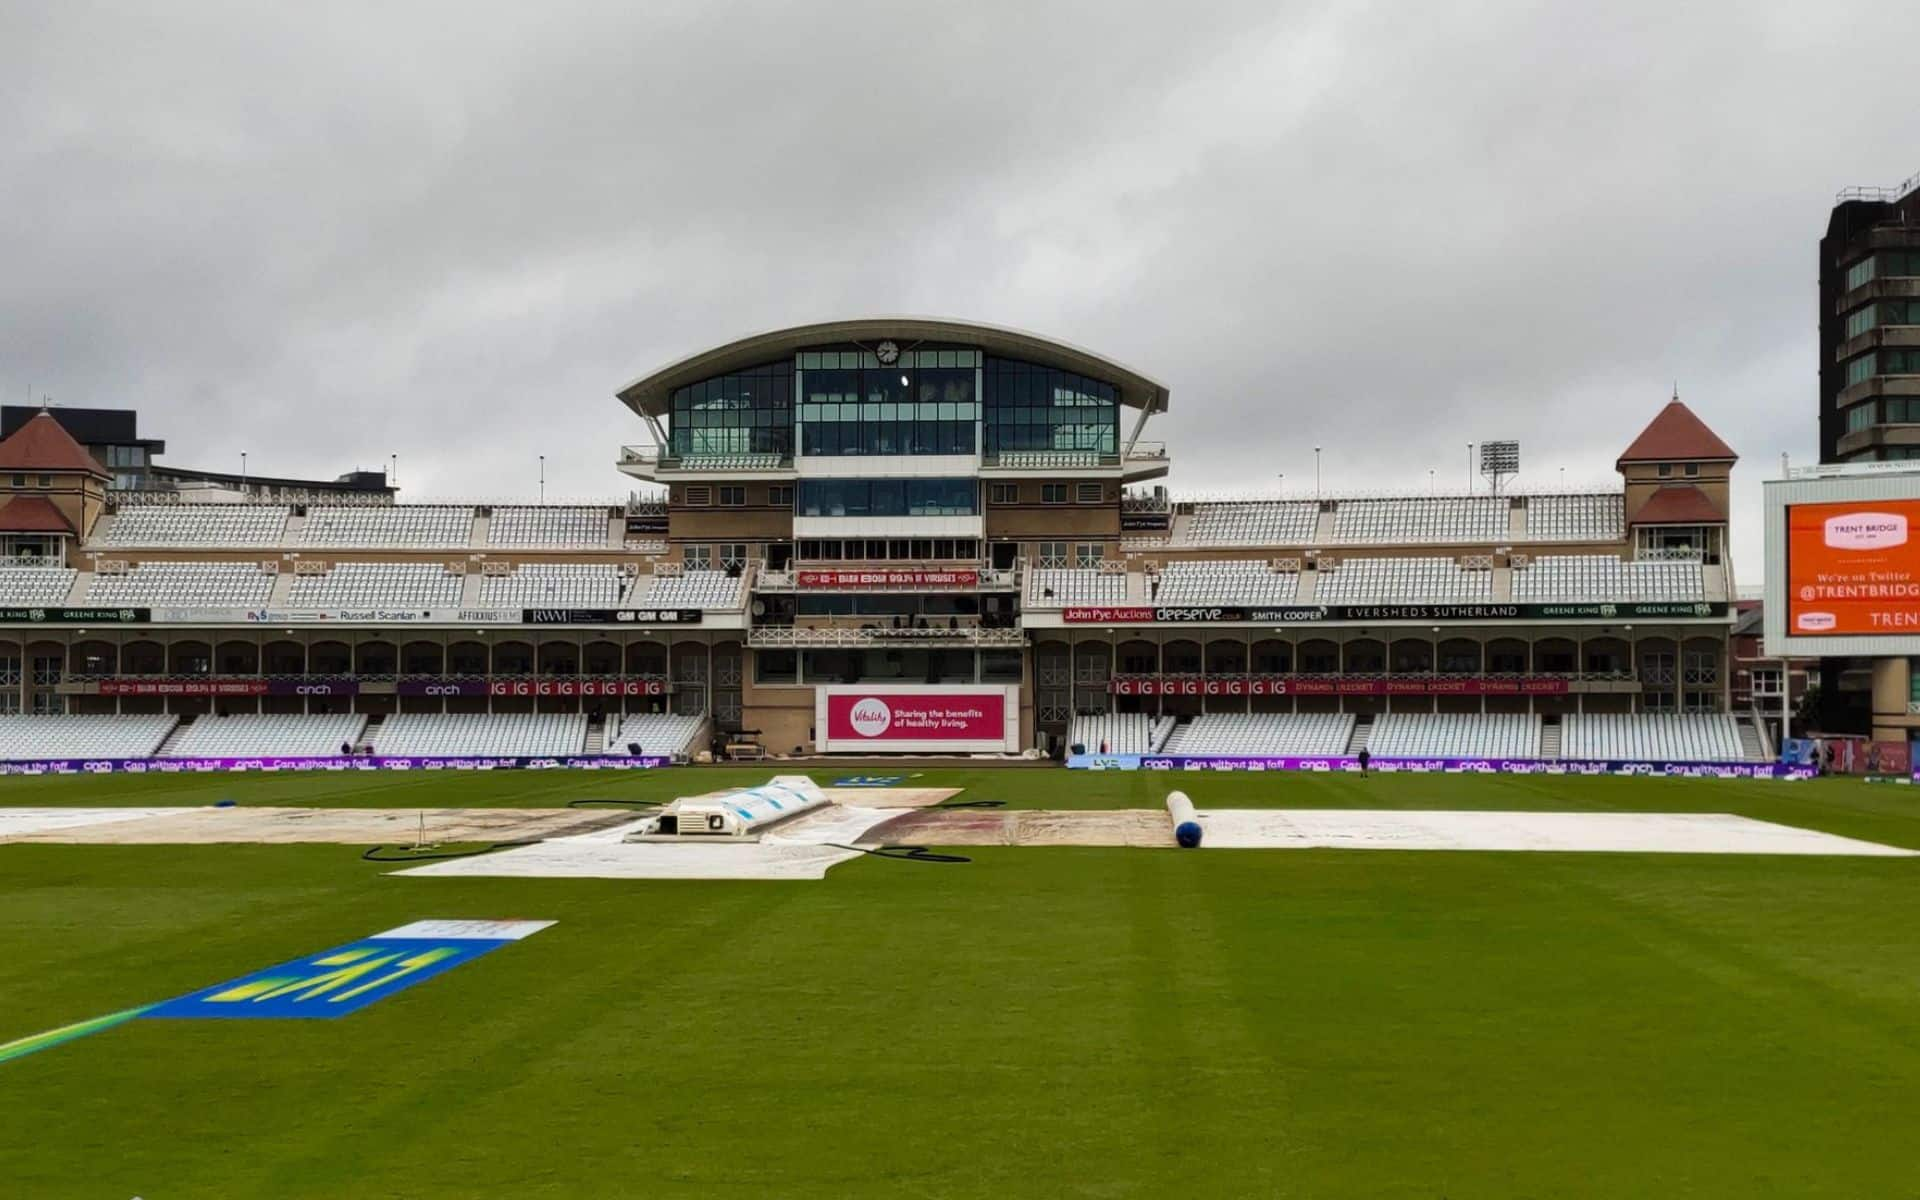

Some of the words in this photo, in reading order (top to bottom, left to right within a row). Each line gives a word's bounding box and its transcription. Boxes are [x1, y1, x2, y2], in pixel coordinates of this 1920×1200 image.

[1834, 525, 1863, 533] TRENT
[1866, 523, 1898, 532] BRIDGE
[1817, 573, 1848, 583] We're
[1869, 571, 1911, 581] Twitter
[1800, 583, 1920, 601] @TRENTBRIDG
[29, 608, 46, 621] IPA
[119, 608, 136, 621] IPA
[1347, 607, 1429, 617] EVERSHEDS
[1434, 606, 1518, 617] SUTHERLAND
[1578, 606, 1600, 615] KING
[1672, 605, 1693, 614] KING
[1695, 602, 1712, 617] IPA
[340, 611, 376, 621] Russell
[377, 611, 417, 621] Scanlan
[532, 610, 567, 623] RWM
[1065, 610, 1091, 621] John
[1093, 610, 1112, 622] Pye
[1113, 609, 1152, 621] Auctions
[1252, 611, 1281, 621] SMITH
[1284, 610, 1323, 621] COOPER
[1870, 612, 1919, 626] TREN
[296, 685, 332, 695] cinch
[425, 685, 460, 695] cinch
[491, 682, 506, 695] IG
[513, 682, 528, 695] IG
[535, 682, 551, 695] IG
[557, 682, 573, 695] IG
[580, 682, 595, 695] IG
[602, 682, 617, 695] IG
[624, 682, 639, 695] IG
[645, 682, 660, 695] IG
[1115, 681, 1131, 694] IG
[1138, 681, 1153, 694] IG
[1160, 681, 1175, 694] IG
[1182, 681, 1197, 694] IG
[1204, 681, 1219, 694] IG
[1226, 681, 1241, 694] IG
[1248, 681, 1264, 694] IG
[1271, 681, 1286, 694] IG
[854, 708, 887, 726] Vitality
[894, 709, 927, 720] Sharing
[929, 709, 944, 718] the
[945, 709, 983, 718] benefits
[894, 719, 905, 728] of
[906, 719, 940, 729] healthy
[941, 719, 969, 729] living.
[49, 762, 70, 773] faff
[123, 760, 147, 770] Cars
[149, 760, 184, 770] without
[187, 760, 203, 770] the
[203, 760, 222, 770] faff
[235, 759, 264, 769] cinch
[273, 760, 296, 769] Cars
[296, 760, 332, 769] without
[334, 760, 351, 769] the
[352, 760, 370, 769] faff
[383, 760, 412, 768] cinch
[422, 759, 444, 768] Cars
[446, 759, 480, 768] without
[482, 759, 497, 768] the
[499, 759, 517, 768] faff
[567, 758, 588, 768] Cars
[590, 758, 624, 768] without
[626, 758, 641, 768] the
[642, 758, 661, 768] faff
[1144, 760, 1174, 769] cinch
[1184, 760, 1208, 770] Cars
[1209, 760, 1246, 770] without
[1249, 760, 1265, 770] the
[1265, 760, 1286, 770] faff
[1300, 760, 1329, 769] cinch
[1340, 760, 1360, 770] Car
[1459, 761, 1490, 770] cinch
[1623, 762, 1654, 772] cinch
[1665, 763, 1689, 775] Cars
[1691, 763, 1731, 775] without
[1733, 763, 1751, 775] the
[1753, 763, 1774, 775] faff
